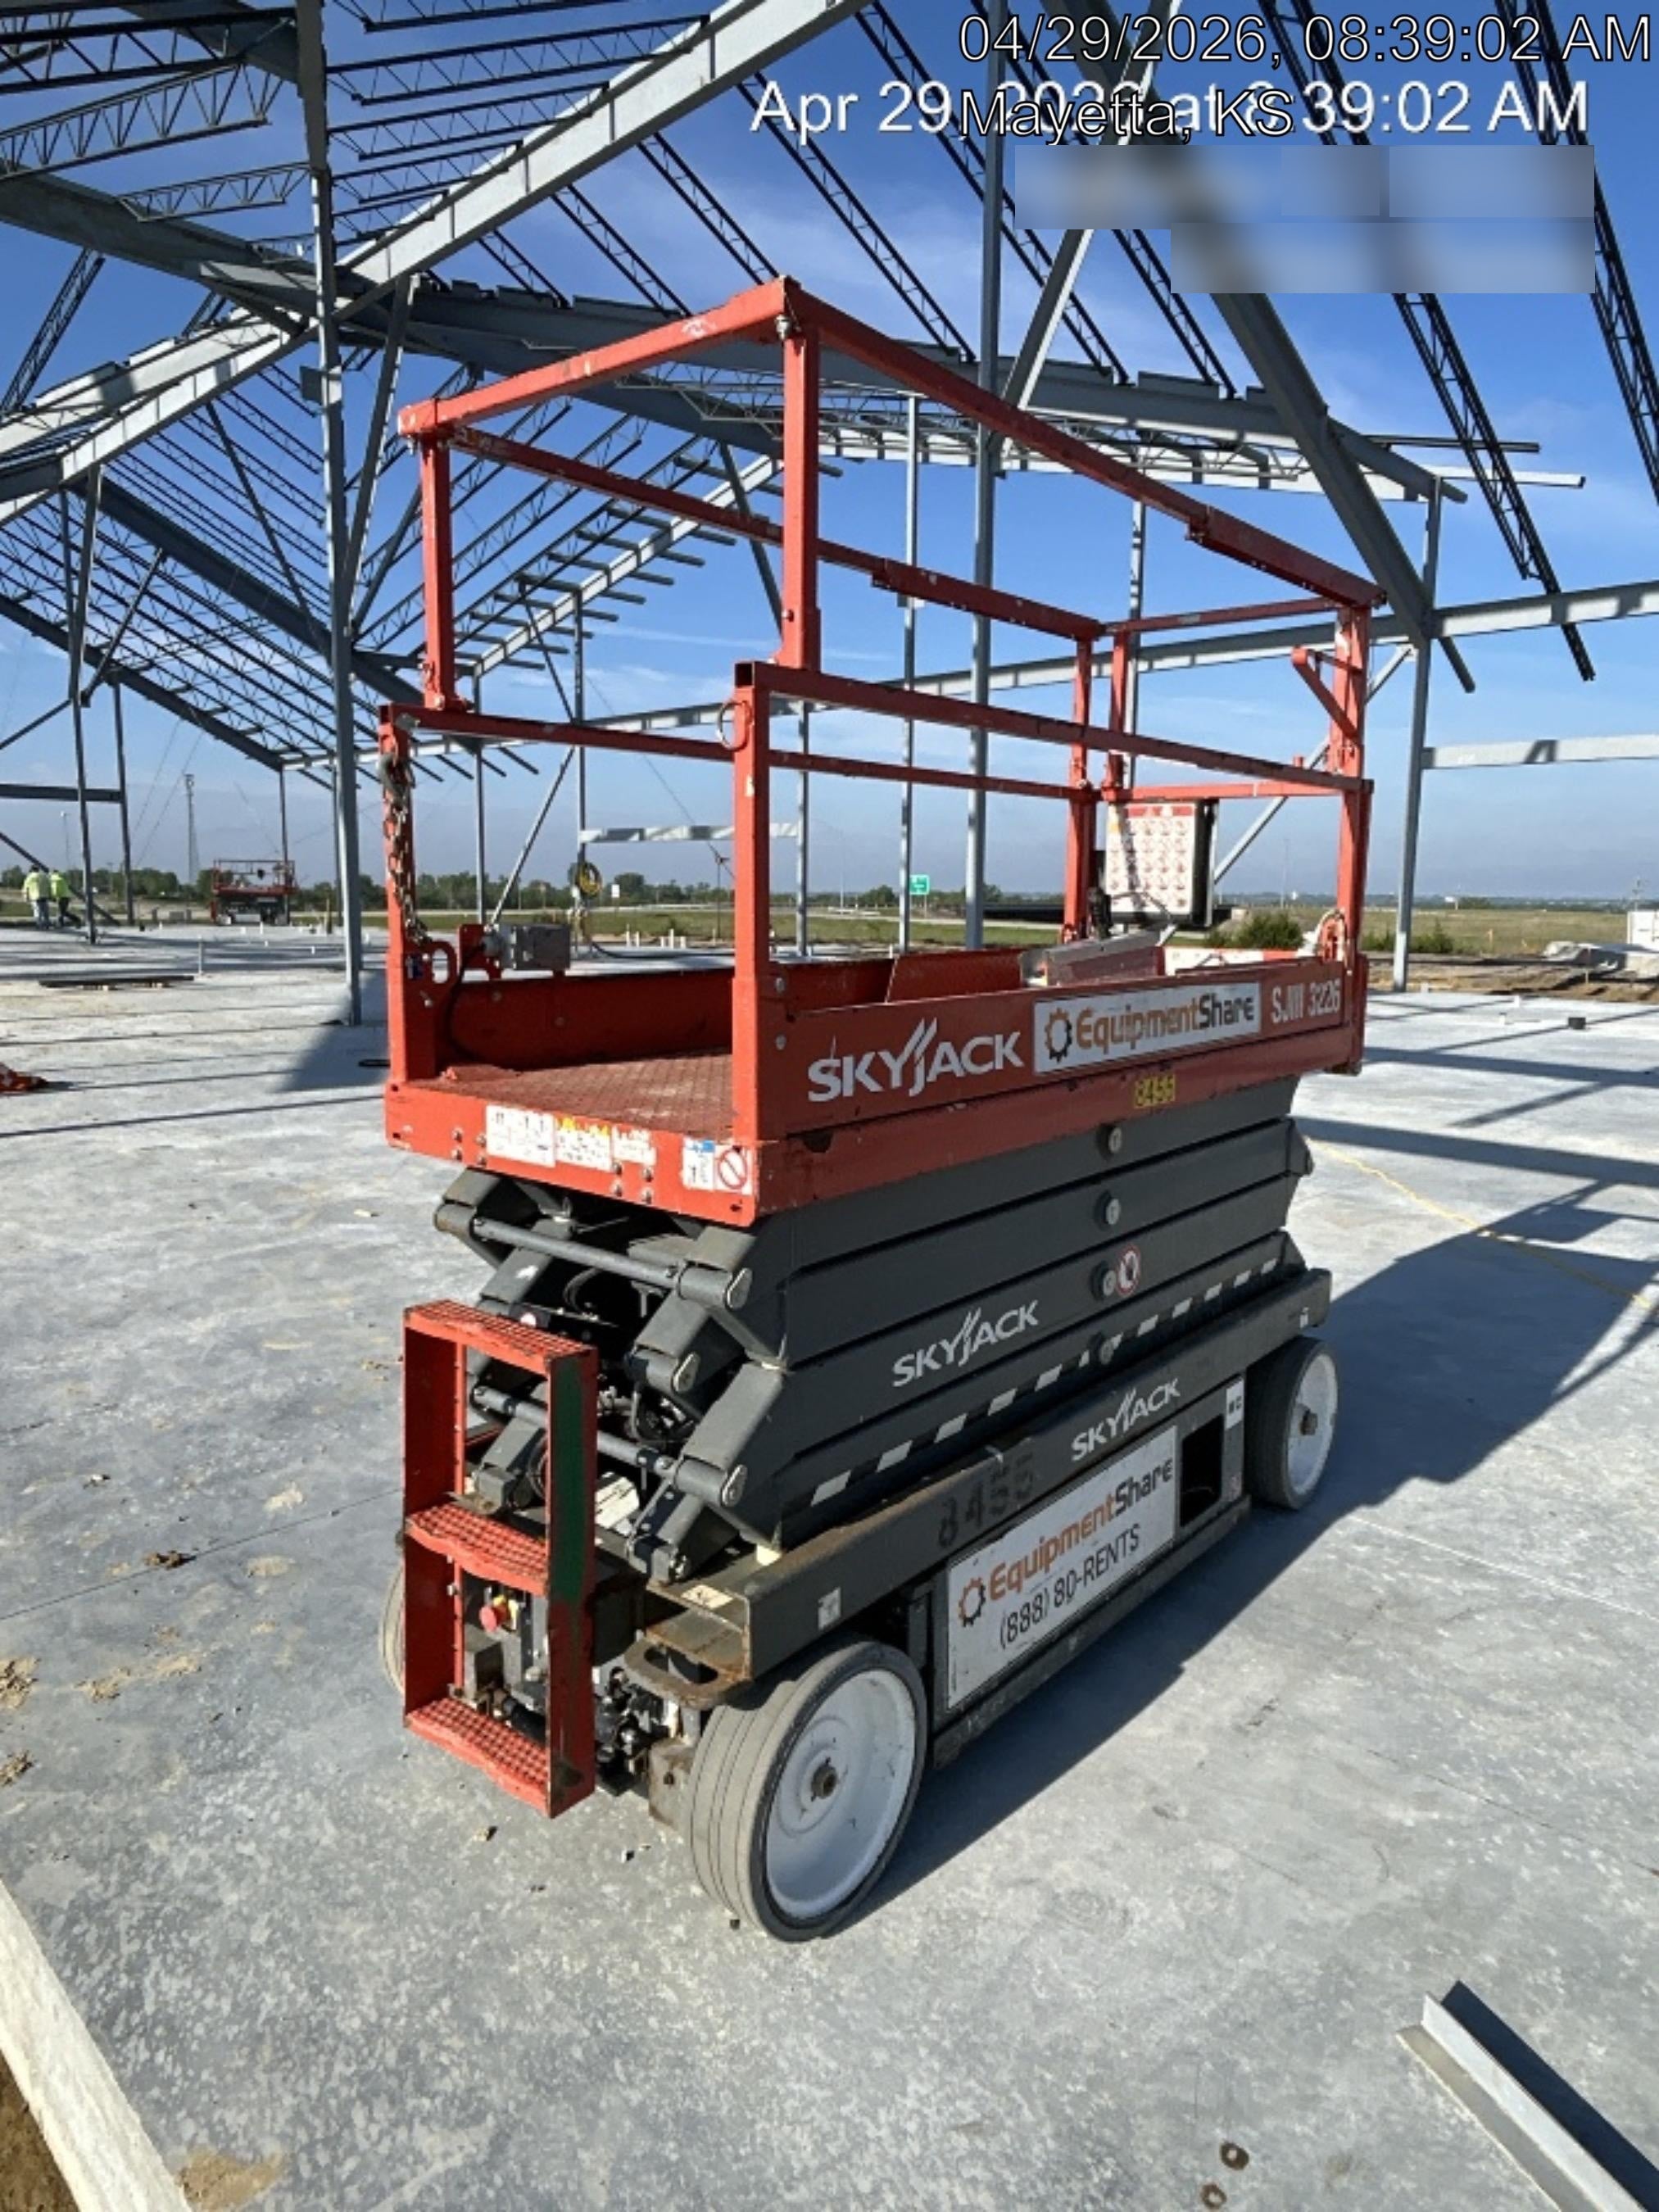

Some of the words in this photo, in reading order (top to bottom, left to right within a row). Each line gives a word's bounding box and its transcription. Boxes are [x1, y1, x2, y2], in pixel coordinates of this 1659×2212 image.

[807, 1017, 1024, 1102] SKYJACK
[1076, 992, 1255, 1054] EquipmentShare
[891, 1300, 1039, 1387] SKYJACK
[1071, 1378, 1181, 1462] SKYJACK
[989, 1457, 1174, 1602] EquipmentShare
[999, 1587, 1050, 1650] (888)
[1054, 1522, 1141, 1608] 80-RENTS
